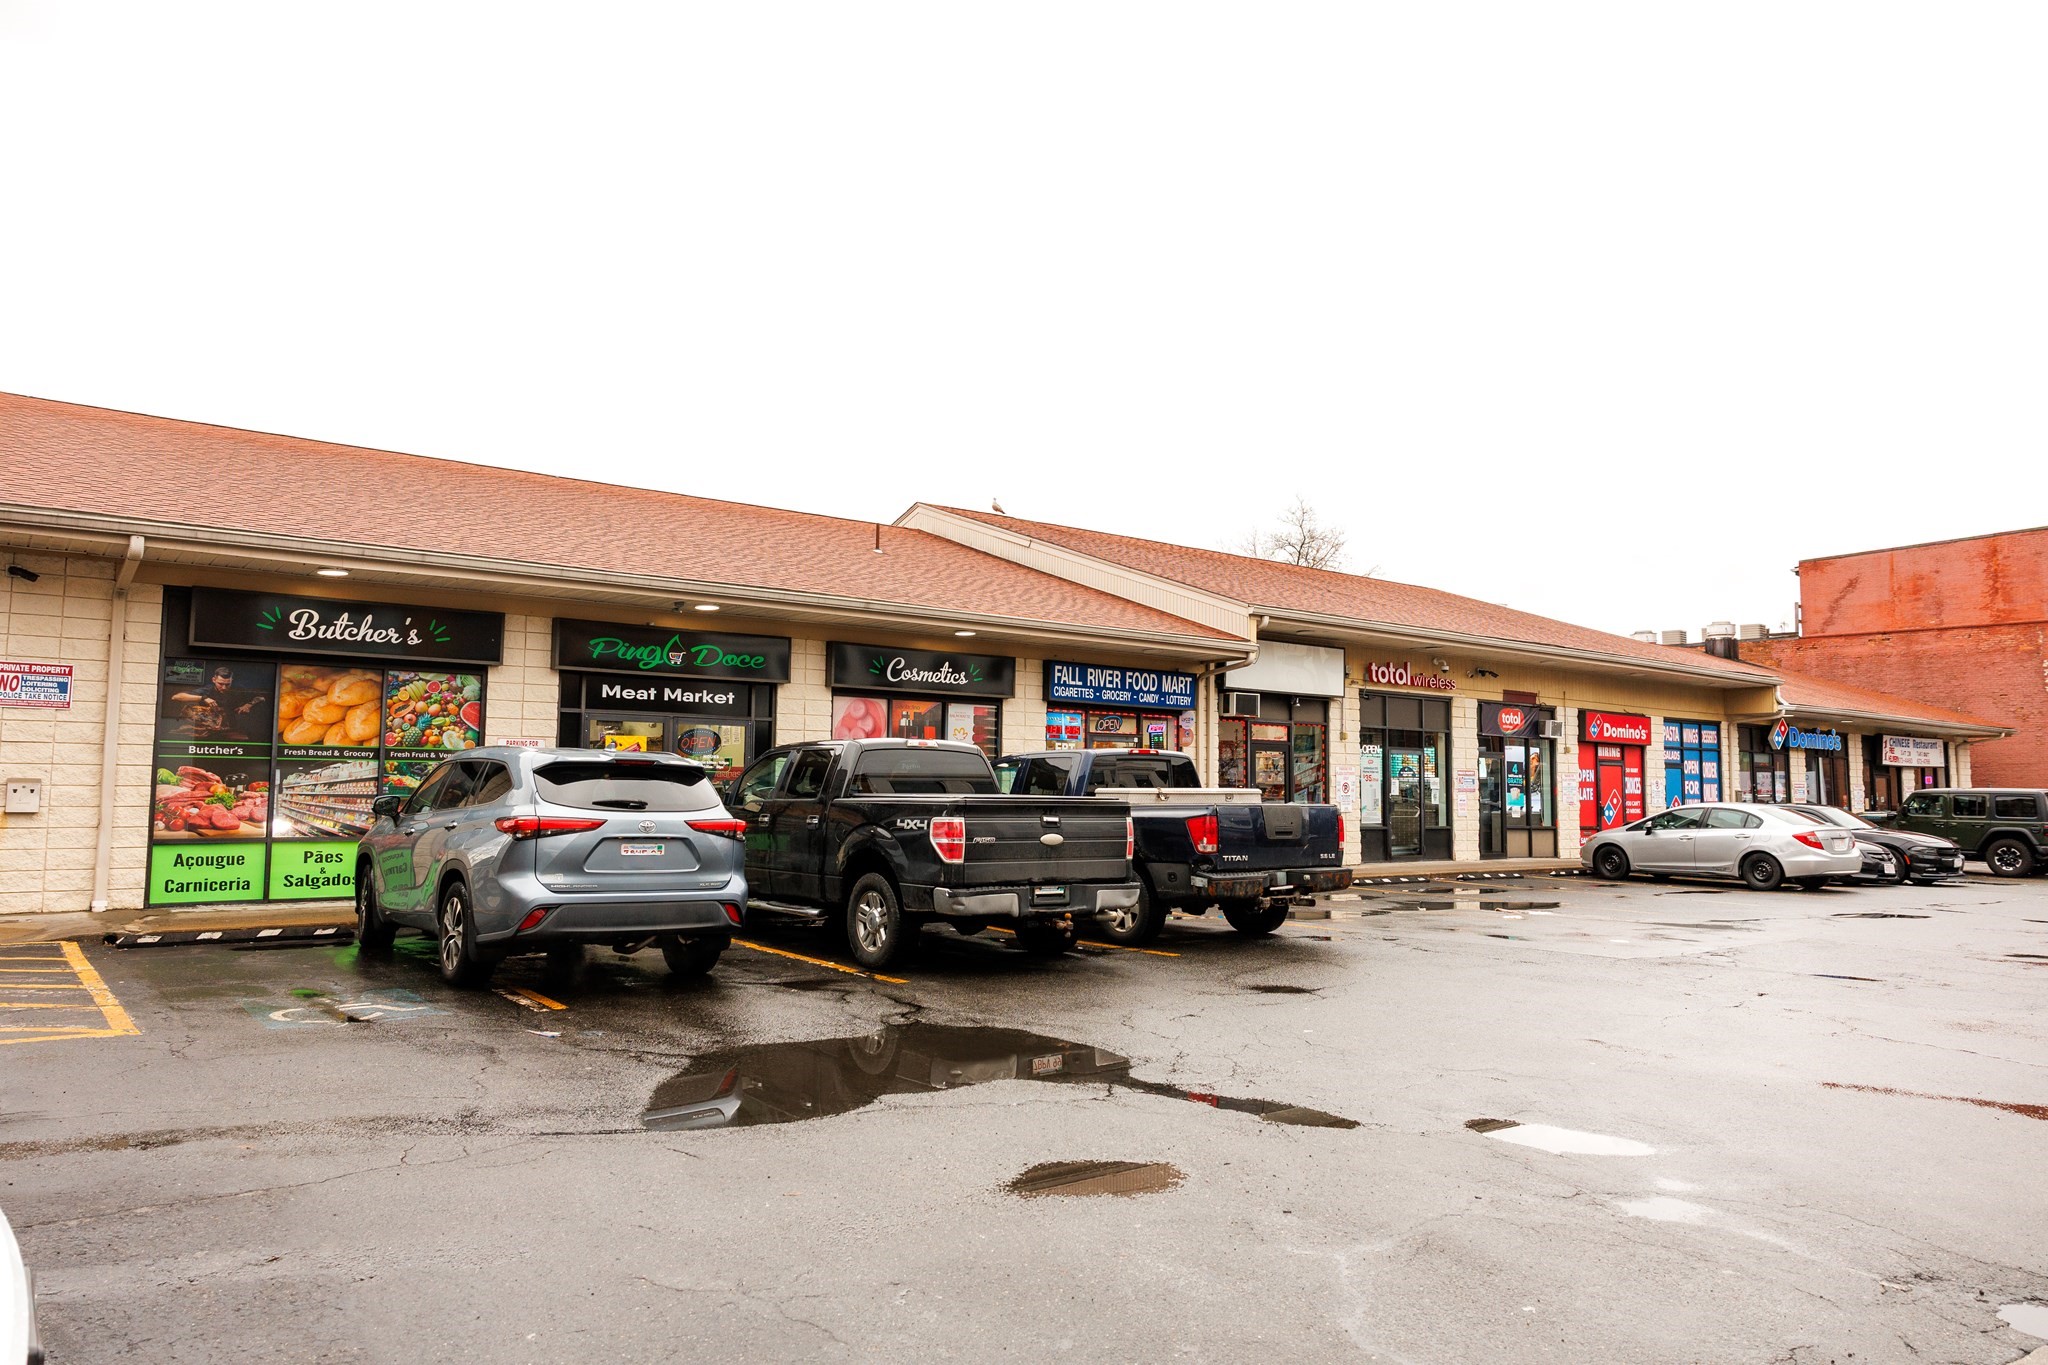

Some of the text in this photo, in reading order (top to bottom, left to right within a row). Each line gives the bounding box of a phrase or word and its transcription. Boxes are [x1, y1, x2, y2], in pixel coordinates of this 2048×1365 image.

[288, 608, 423, 645] Butcher's
[691, 645, 766, 669] Doce
[0, 664, 70, 674] PRIVATE PROPERTY
[886, 657, 968, 685] Cosmetics
[1054, 665, 1192, 694] FALL RIVER FOOD MART
[1371, 662, 1457, 690] total wireless
[0, 675, 20, 692] NO
[0, 691, 22, 699] POLICE
[601, 684, 735, 705] Meat Market
[1053, 686, 1094, 699] CIGARETTES
[1102, 690, 1132, 701] GROCERY
[1138, 692, 1159, 704] CANDY
[1166, 694, 1192, 706] LOTTERY
[1097, 719, 1120, 731] OPEN
[1502, 712, 1521, 725] total
[1603, 722, 1647, 740] Domino's
[1664, 726, 1680, 742] PASTA
[681, 735, 717, 749] OPEN
[1789, 726, 1842, 751] Domino's
[1889, 738, 1910, 748] CHINESE
[188, 745, 244, 755] Butcher's
[284, 748, 375, 759] Fresh Bread & Grocery
[390, 751, 410, 759] Fresh
[411, 751, 429, 759] Fruit
[1362, 745, 1380, 754] OPEN
[1598, 746, 1620, 757] HIRING
[1664, 751, 1680, 760] SALADS
[1512, 763, 1518, 774] 4
[1684, 760, 1699, 774] OPEN
[1579, 769, 1594, 782] OPEN
[1580, 787, 1594, 800] LATE
[1685, 781, 1700, 794] FOR
[173, 853, 246, 870] Açougue
[303, 850, 344, 864] Pães
[319, 867, 326, 875] &
[164, 877, 250, 893] Carniceria
